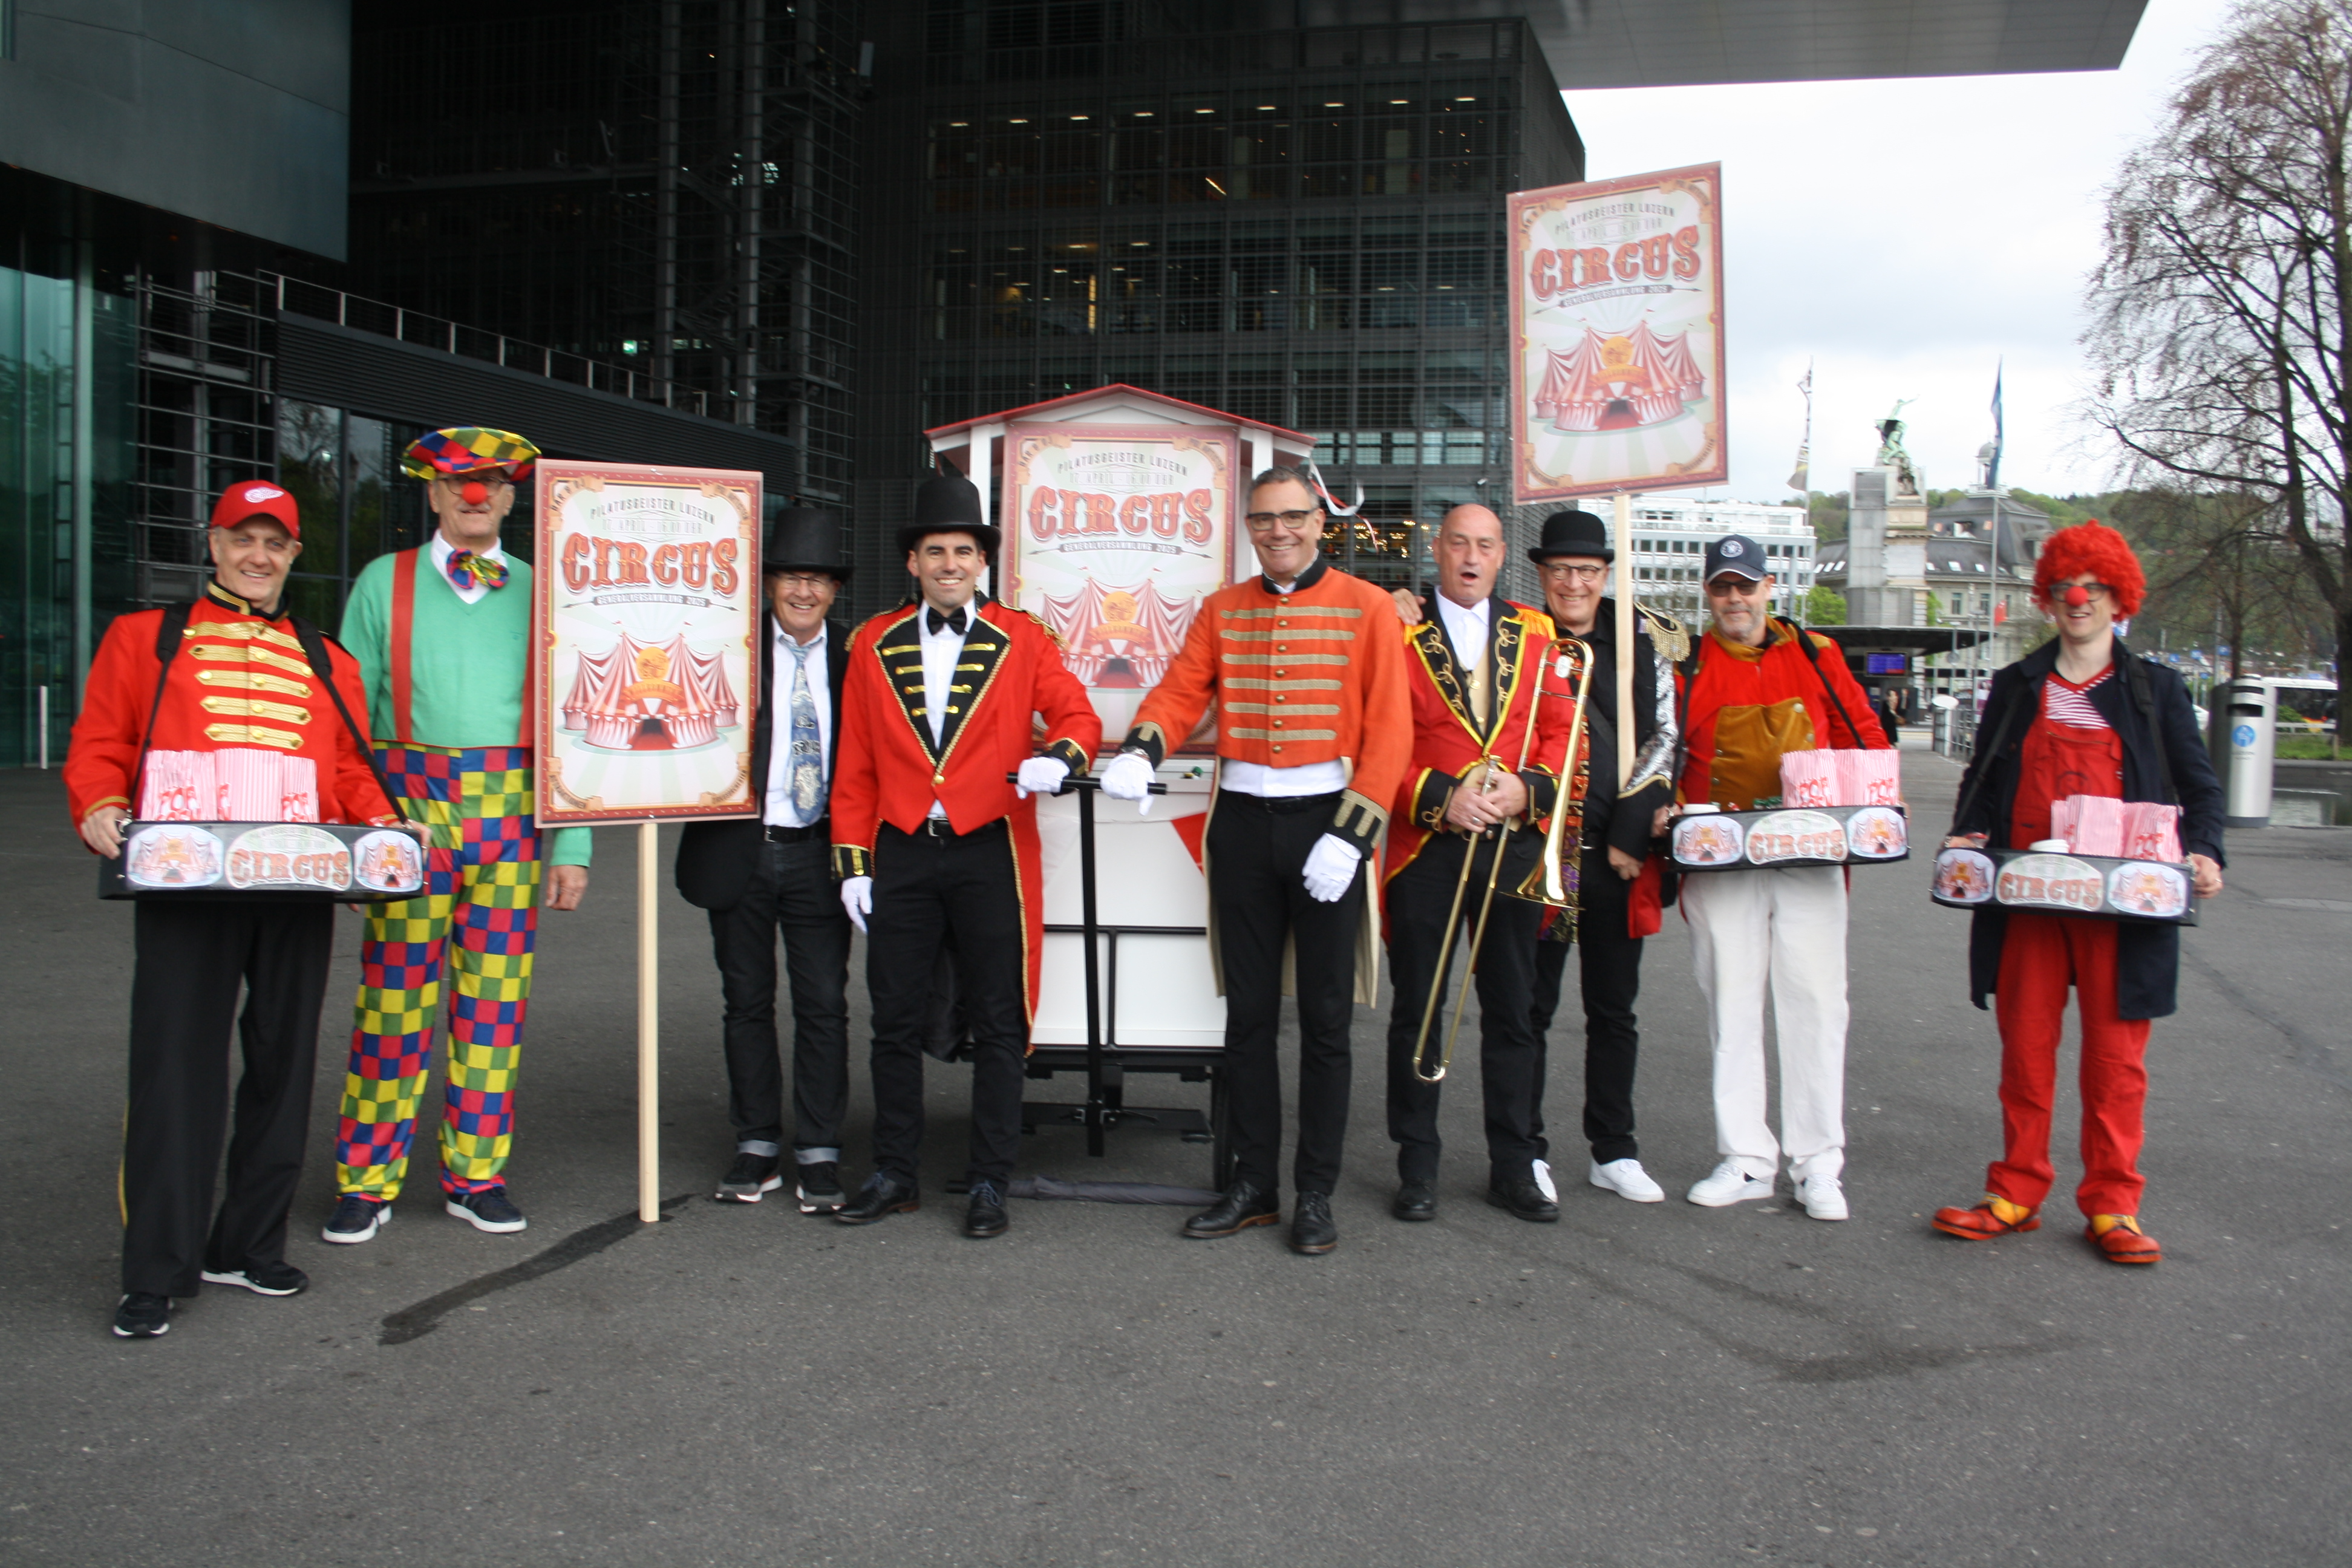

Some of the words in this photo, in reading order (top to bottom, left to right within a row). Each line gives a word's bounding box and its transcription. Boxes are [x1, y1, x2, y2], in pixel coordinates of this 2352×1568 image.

[1555, 203, 1634, 235] PILATUSGEISTER
[1638, 203, 1675, 218] LUZERN
[1531, 226, 1700, 301] CIRCUS
[1564, 286, 1645, 307] GENERALVERSAMMLUNG
[1648, 285, 1668, 293] 2025
[1057, 451, 1146, 474] PILATUSGEISTER
[1149, 455, 1188, 477] LUZERN
[590, 497, 676, 520] PILATUSGEISTER
[679, 498, 716, 525] LUZERN
[1028, 485, 1214, 547] CIRCUS
[1062, 541, 1153, 552] GENERALVERSAMMLUNG
[1156, 544, 1177, 554] 2025
[560, 532, 739, 599] CIRCUS
[596, 593, 684, 604] GENERALVERSAMMLUNG
[686, 596, 707, 607] 2025
[1749, 829, 1845, 862] CIRCUS
[231, 848, 350, 886] CIRCUS
[1998, 872, 2101, 909] CIRCUS
